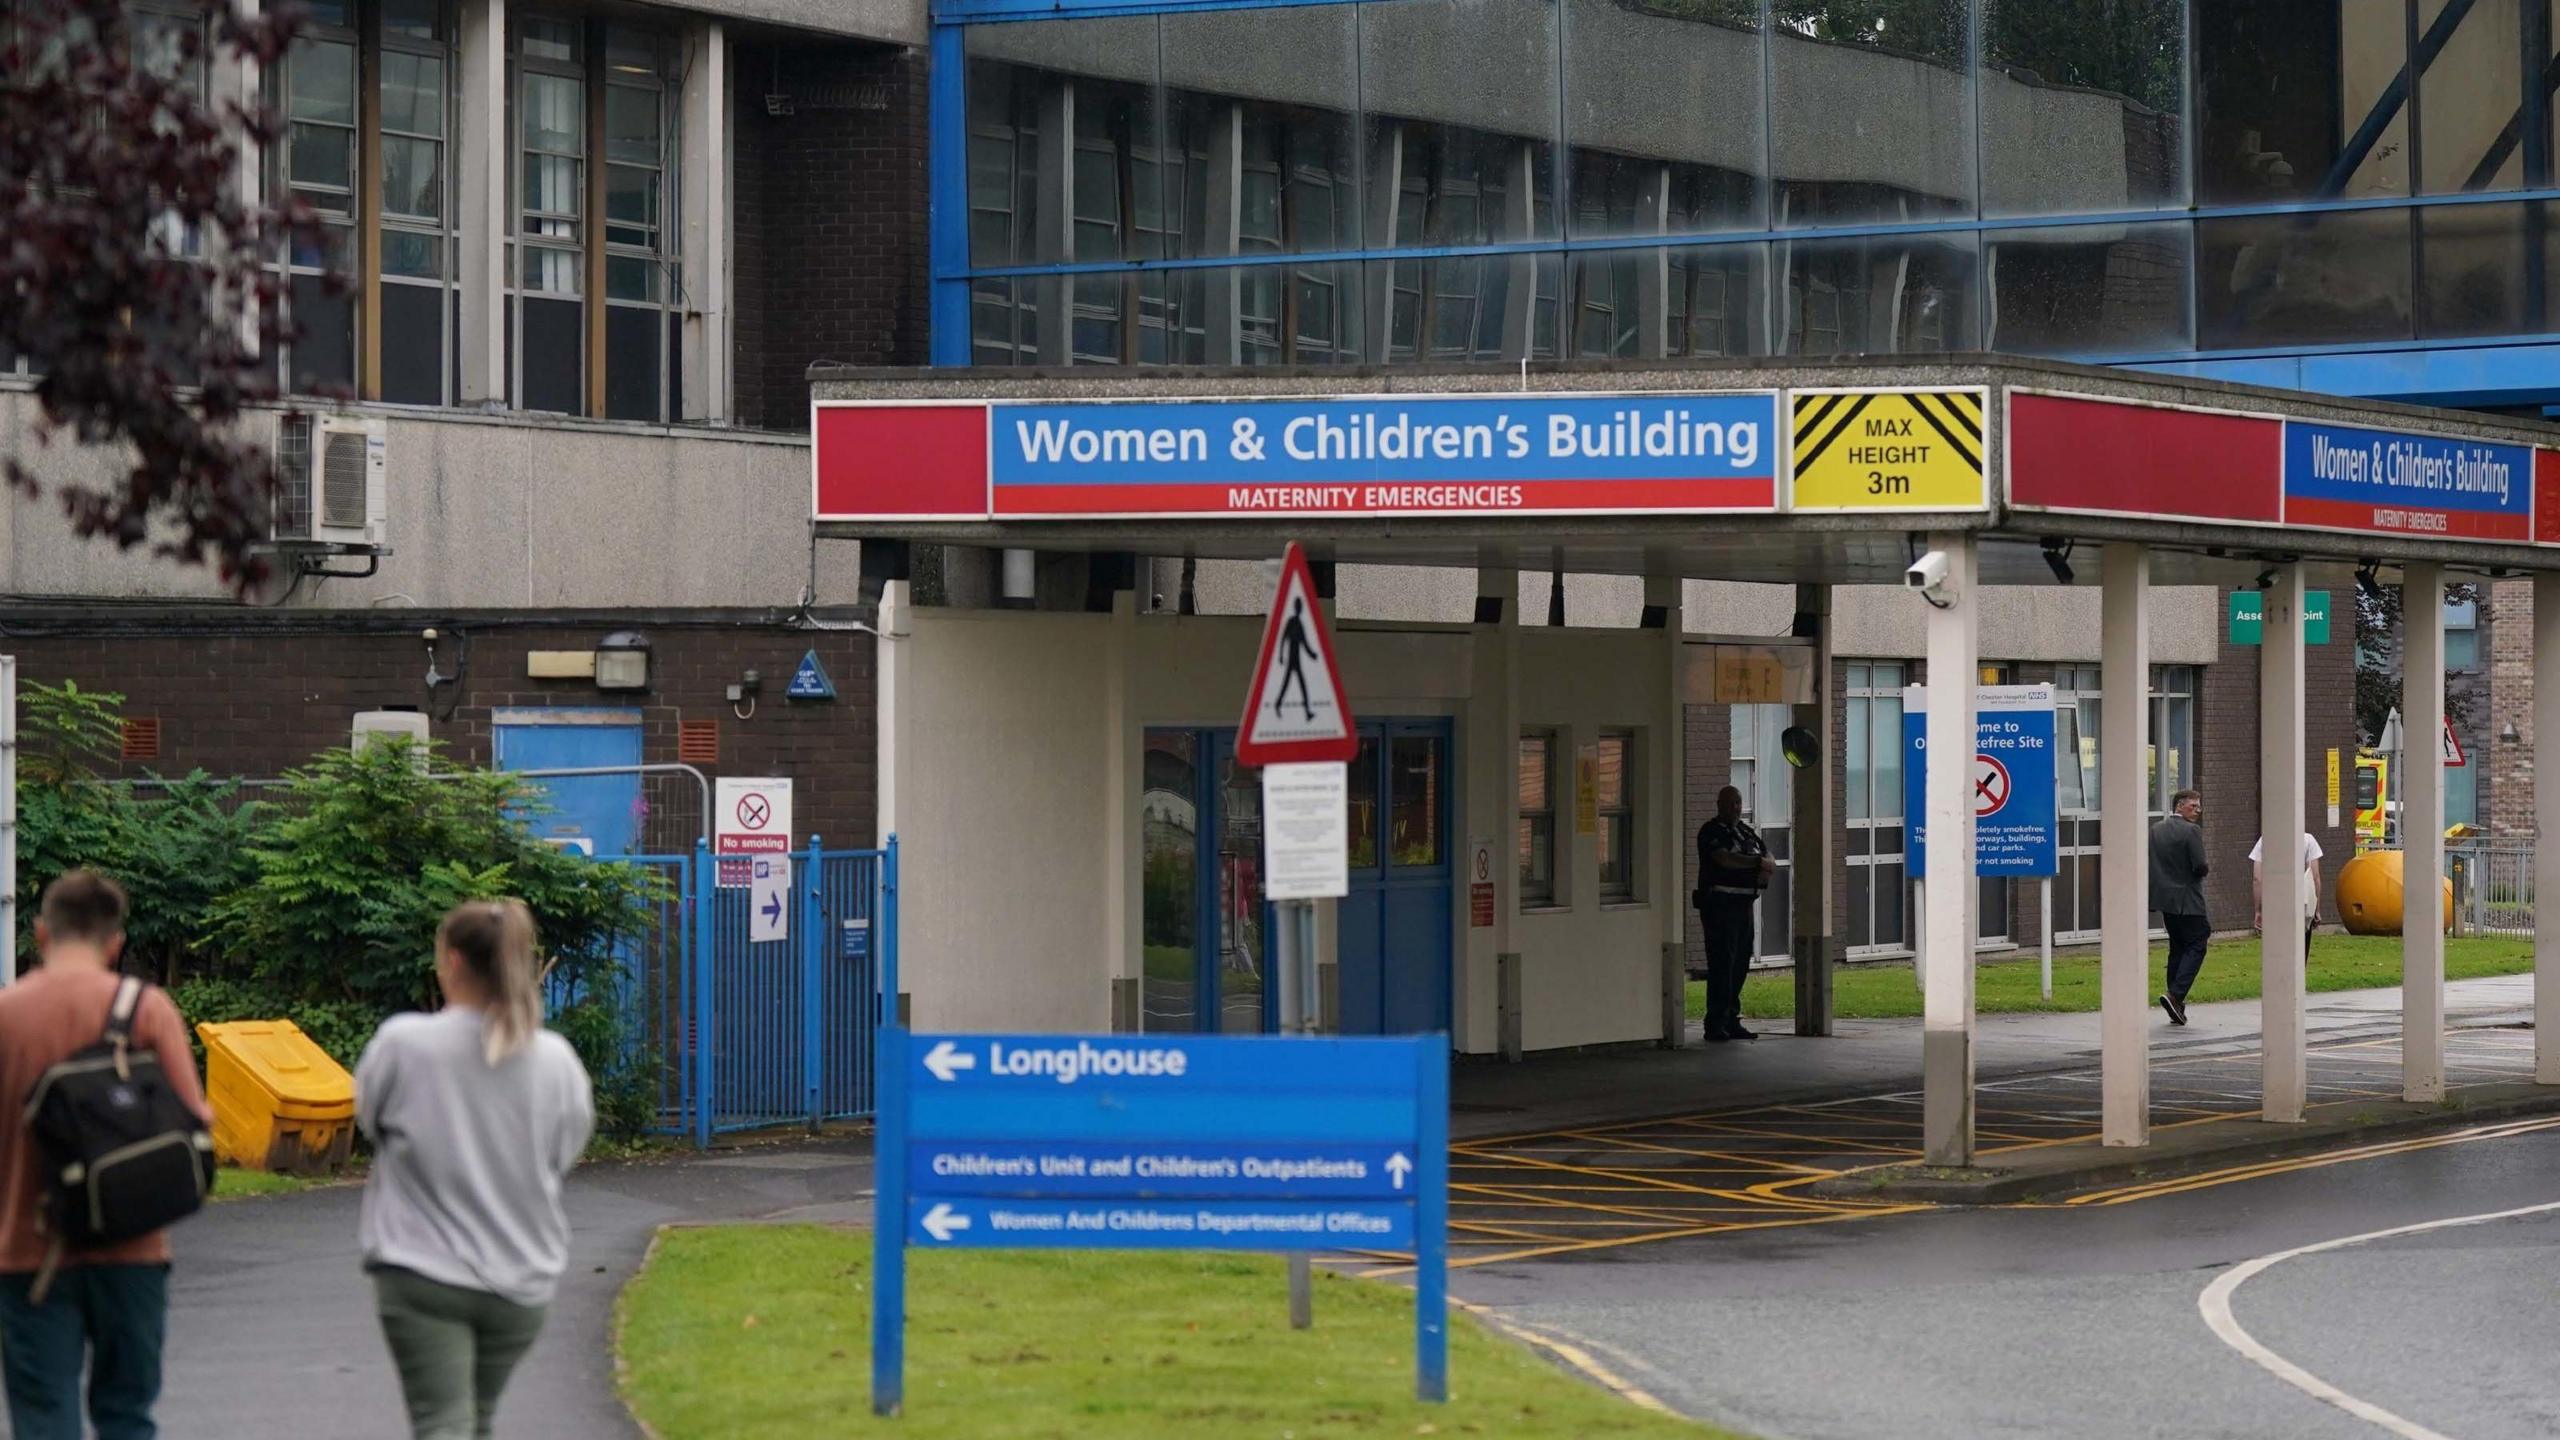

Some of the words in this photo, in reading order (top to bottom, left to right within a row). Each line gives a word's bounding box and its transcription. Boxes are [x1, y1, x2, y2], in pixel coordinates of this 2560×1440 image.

[1865, 419, 1912, 437] MAX
[1016, 419, 1207, 462] Women
[1229, 417, 1266, 461] &
[1283, 412, 1530, 461] Children's
[1548, 410, 1758, 468] Building
[1849, 446, 1931, 464] HEIGHT
[2312, 434, 2368, 483] Women
[2372, 441, 2383, 484] &
[2387, 441, 2452, 490] Children's
[2456, 449, 2510, 506] Building
[1868, 471, 1910, 494] 3m
[1228, 487, 1357, 508] MATERNITY
[1364, 485, 1523, 508] EMERGENCIES
[2374, 508, 2407, 529] MATERNITY
[2408, 512, 2447, 532] EMERGENCIES
[2236, 610, 2262, 621] Asse
[2303, 610, 2323, 620] oint
[2004, 722, 2019, 733] to
[1976, 736, 2015, 748] kefree
[2018, 736, 2044, 748] Site
[723, 837, 738, 848] No
[741, 837, 784, 850] smoking
[1976, 836, 2007, 844] orways,
[2000, 857, 2034, 866] smoking
[990, 1040, 1187, 1084] Longhouse
[933, 1153, 1036, 1177] Children's
[1040, 1154, 1087, 1177] Unit
[1089, 1155, 1132, 1177] and
[1135, 1155, 1239, 1178] Children's
[1242, 1156, 1368, 1182] Outpatients
[990, 1210, 1063, 1231] Women
[1066, 1210, 1106, 1231] And
[1108, 1210, 1195, 1231] Childrens
[1197, 1211, 1324, 1235] Departmental
[1326, 1212, 1392, 1233] Offices
